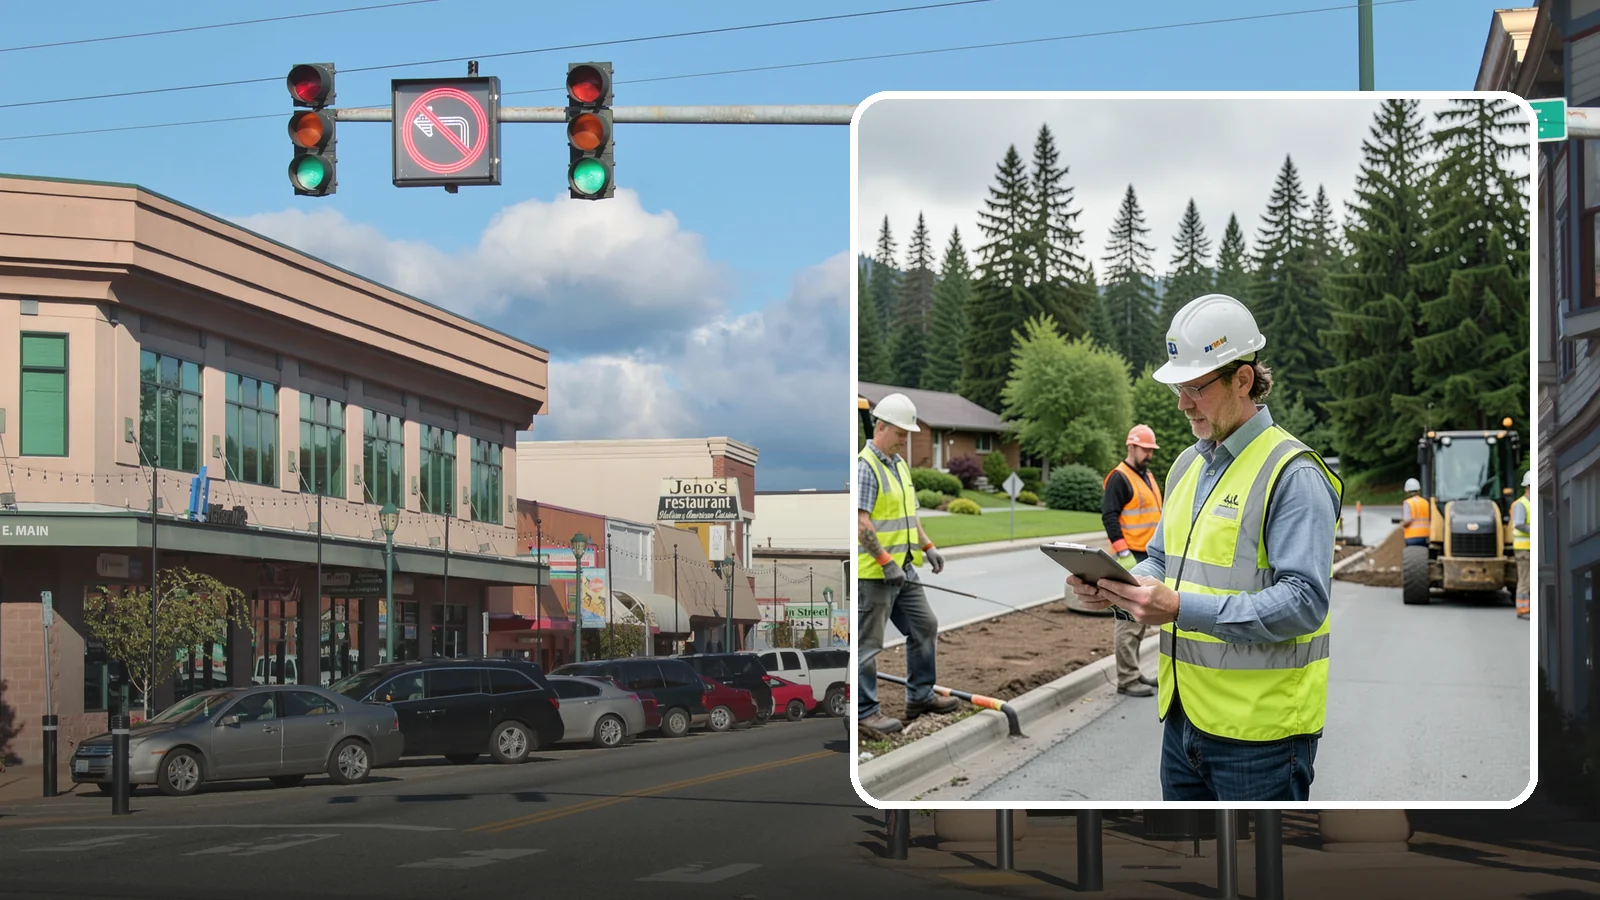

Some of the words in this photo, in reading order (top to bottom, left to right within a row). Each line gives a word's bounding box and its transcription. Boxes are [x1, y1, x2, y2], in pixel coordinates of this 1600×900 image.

[669, 480, 728, 494] Jeno's
[665, 496, 731, 509] restaurant
[658, 510, 681, 519] Italian
[686, 509, 715, 519] American
[715, 509, 738, 519] Cuisine
[2, 525, 13, 536] E.
[15, 525, 49, 536] MAIN
[797, 607, 828, 617] Street
